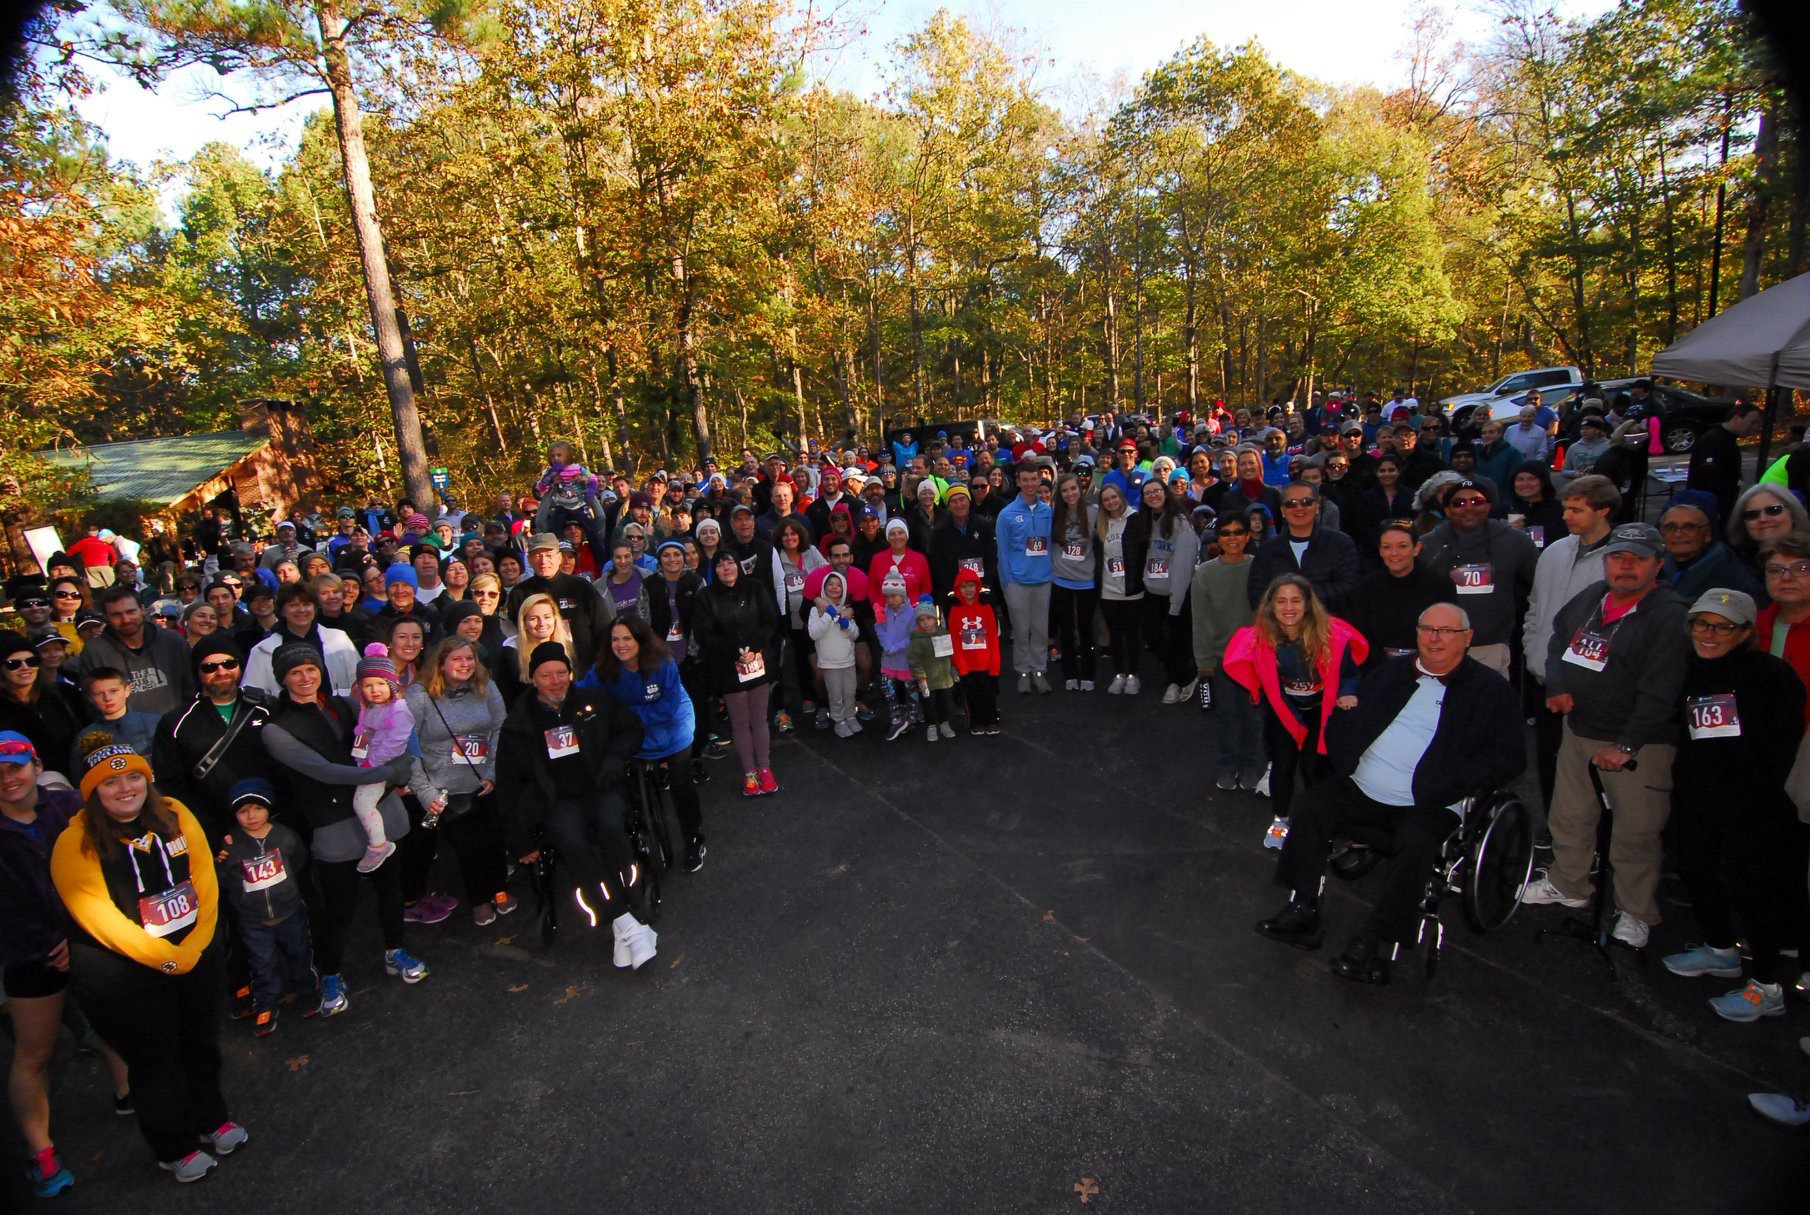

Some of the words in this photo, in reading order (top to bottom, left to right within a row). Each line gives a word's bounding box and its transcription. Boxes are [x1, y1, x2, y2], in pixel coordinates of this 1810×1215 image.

[1033, 541, 1042, 551] 69
[1067, 545, 1081, 556] 128
[1112, 561, 1122, 572] 51
[793, 576, 803, 586] 66
[1463, 571, 1481, 586] 70
[970, 633, 976, 644] 9
[1692, 705, 1723, 727] 163
[558, 731, 573, 747] 37
[465, 741, 479, 756] 20
[249, 860, 277, 882] 143
[157, 894, 191, 923] 108
